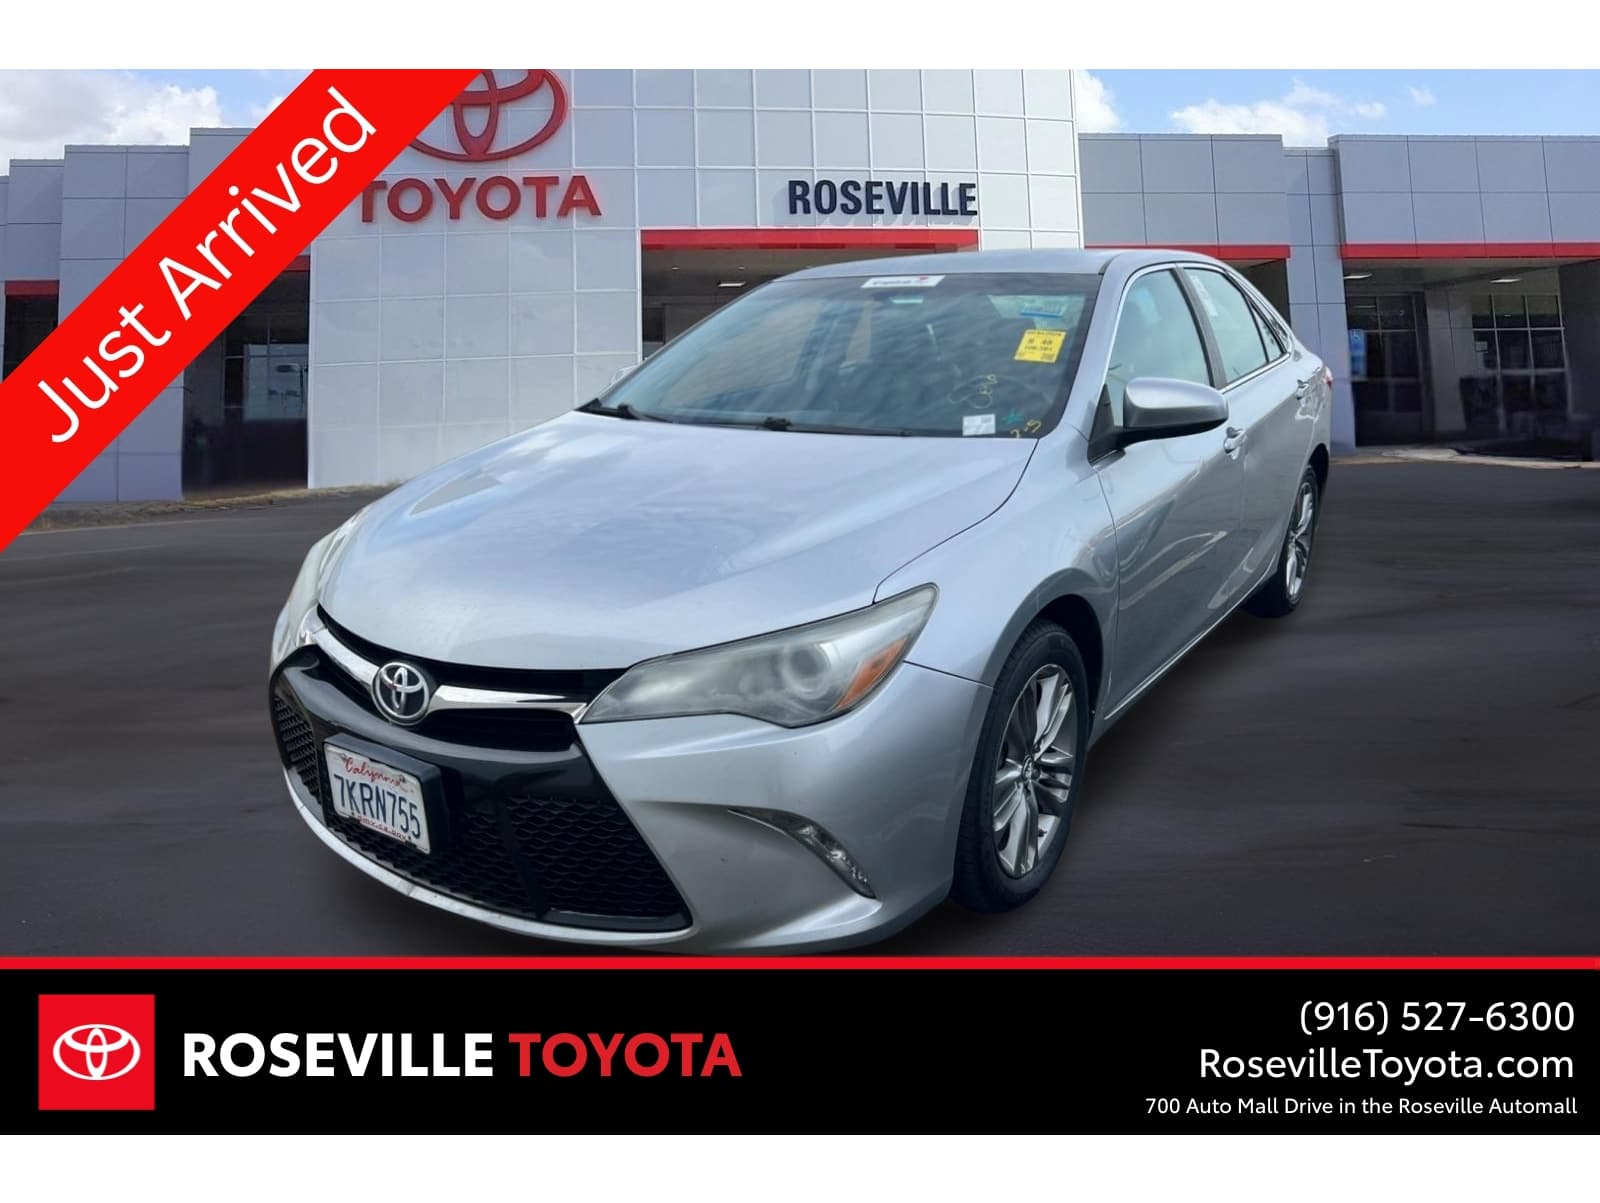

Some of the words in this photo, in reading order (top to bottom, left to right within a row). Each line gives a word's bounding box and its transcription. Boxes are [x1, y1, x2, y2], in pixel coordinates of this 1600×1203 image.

[361, 175, 603, 223] TOYOTA
[788, 179, 978, 216] ROSEVILLE
[333, 773, 421, 839] 7KRN755
